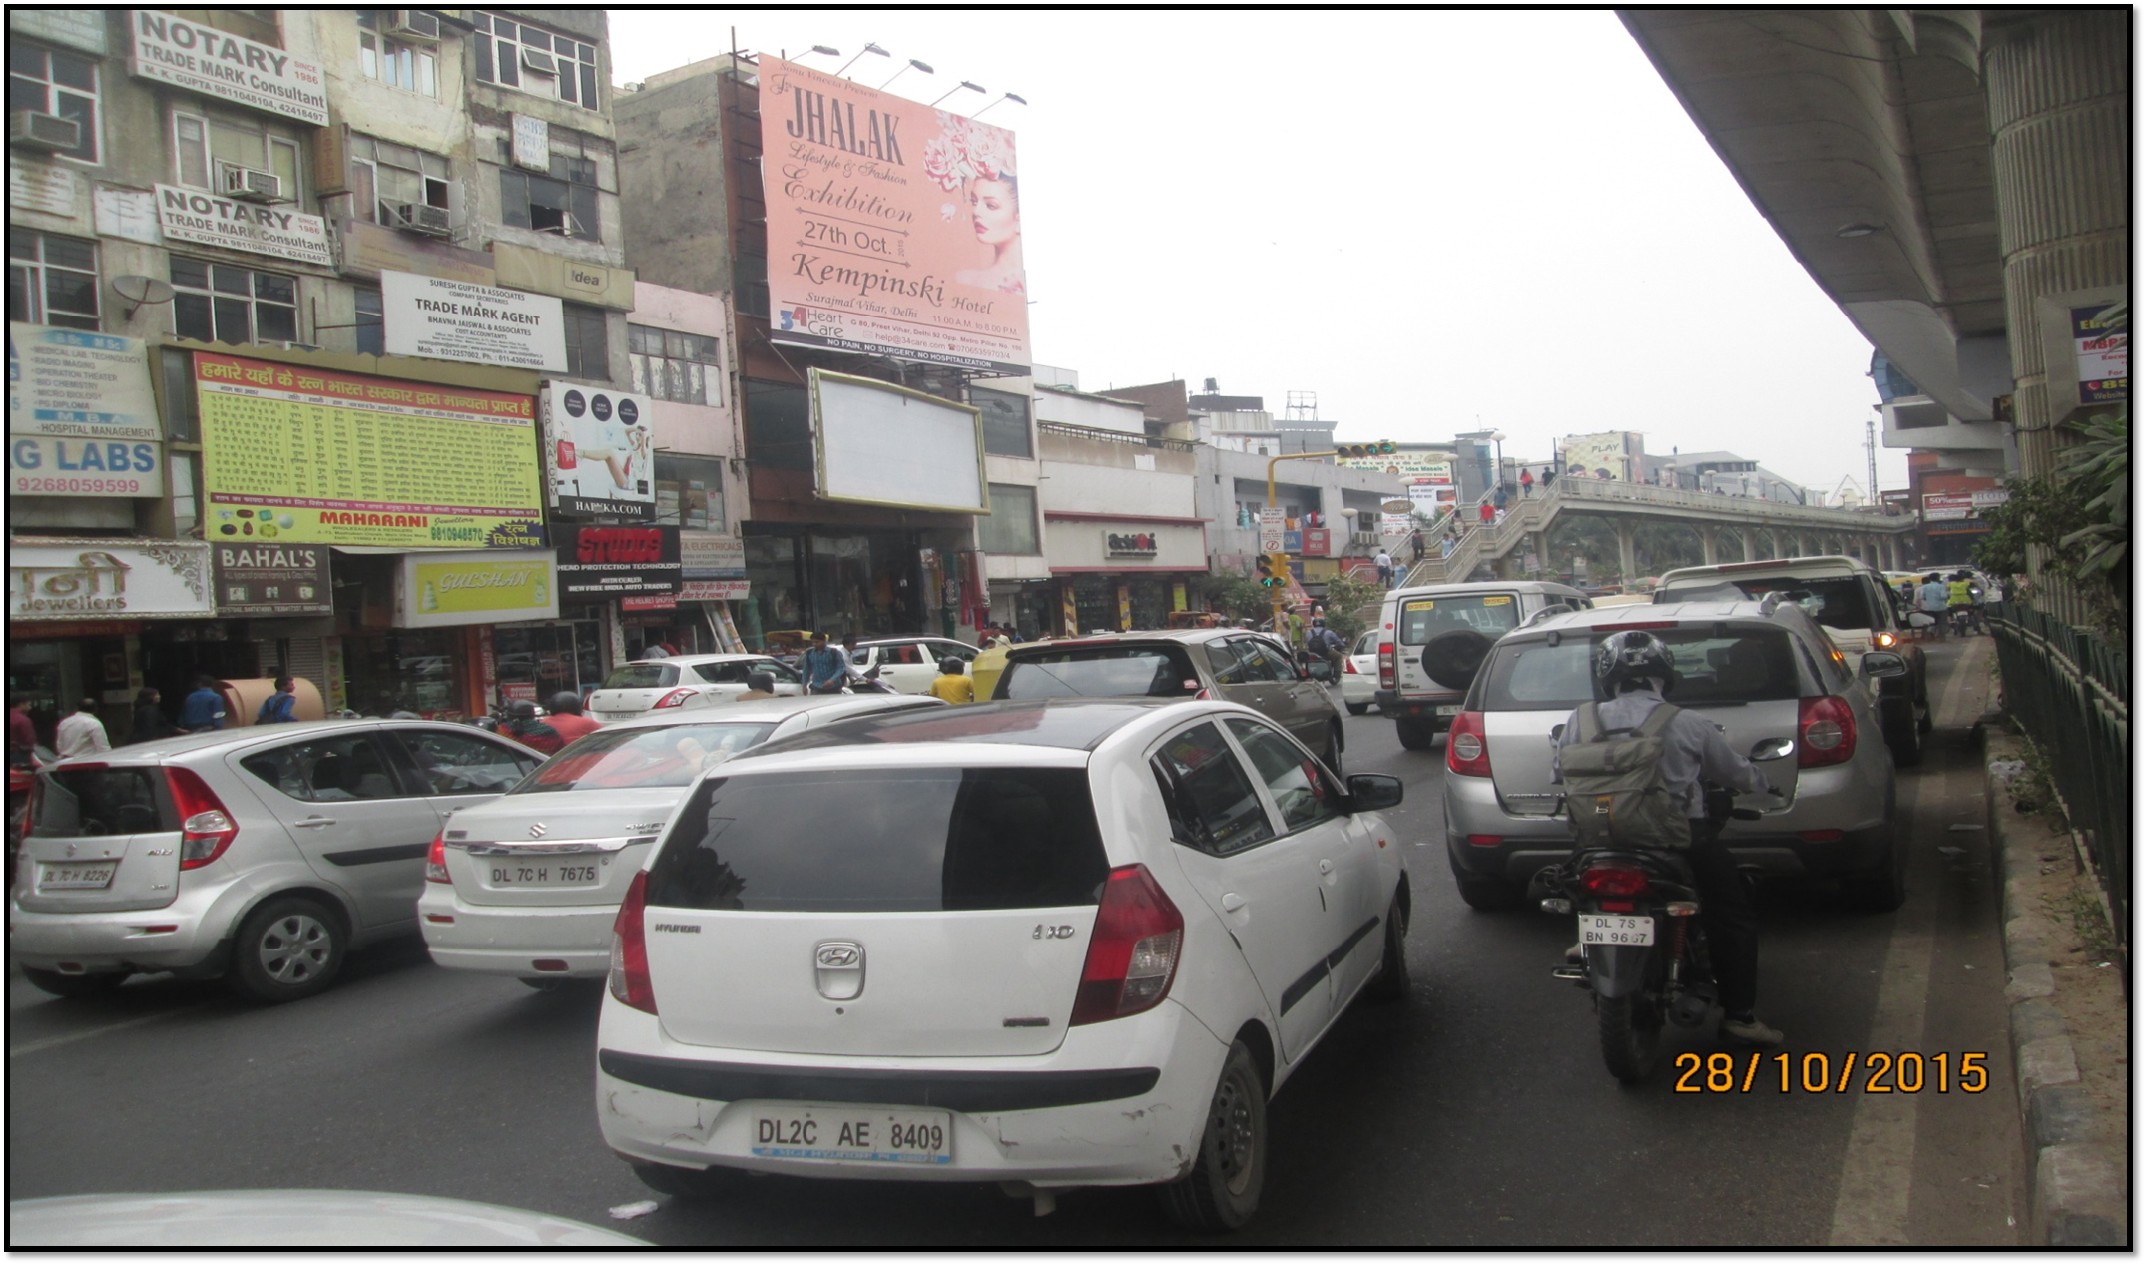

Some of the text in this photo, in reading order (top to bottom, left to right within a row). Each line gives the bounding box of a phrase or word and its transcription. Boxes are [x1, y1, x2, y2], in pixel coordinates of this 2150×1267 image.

[140, 11, 288, 77] NOTARY
[140, 42, 325, 108] TRADE MARK Consultant
[176, 71, 211, 92] GUPTA
[294, 71, 318, 84] 1986
[786, 84, 905, 166] JHALAK
[788, 140, 841, 173] Lifestyle
[858, 161, 908, 186] Fashion
[783, 165, 914, 224] Exhibition
[163, 189, 293, 231] NOTARY
[167, 212, 327, 252] TRADE MARK Consultant
[197, 234, 228, 245] GUPTA
[804, 220, 892, 255] 27th Oct.
[429, 279, 457, 290] SURESH
[457, 284, 480, 293] GUPTA
[487, 288, 525, 301] ASSOCIATES
[791, 253, 994, 315] Kempinski Hotel
[449, 291, 475, 301] COMPANY
[415, 298, 541, 326] TRADE MARK AGENT
[807, 308, 843, 325] Heart
[494, 323, 532, 336] ASSOCIATES
[807, 320, 844, 338] Care
[826, 338, 840, 346] NO
[864, 344, 876, 352] NO
[918, 351, 929, 359] NO
[277, 369, 294, 387] के
[328, 380, 364, 397] भारत
[367, 385, 413, 402] सरकार
[41, 423, 155, 438] HOSPITAL MANAGEMENT
[56, 441, 155, 473] LABS
[17, 477, 140, 493] 9268059599
[319, 511, 428, 528] MAHARANI
[222, 549, 316, 568] BAHAL'S
[557, 564, 580, 572] HEAD
[581, 563, 631, 571] PROTECTION
[439, 570, 531, 593] GULSHAN
[493, 866, 595, 883] DL 7C H 7675
[1596, 918, 1636, 929] DL 7S
[1586, 932, 1603, 942] BN
[758, 1118, 943, 1151] DL2C AE 8409
